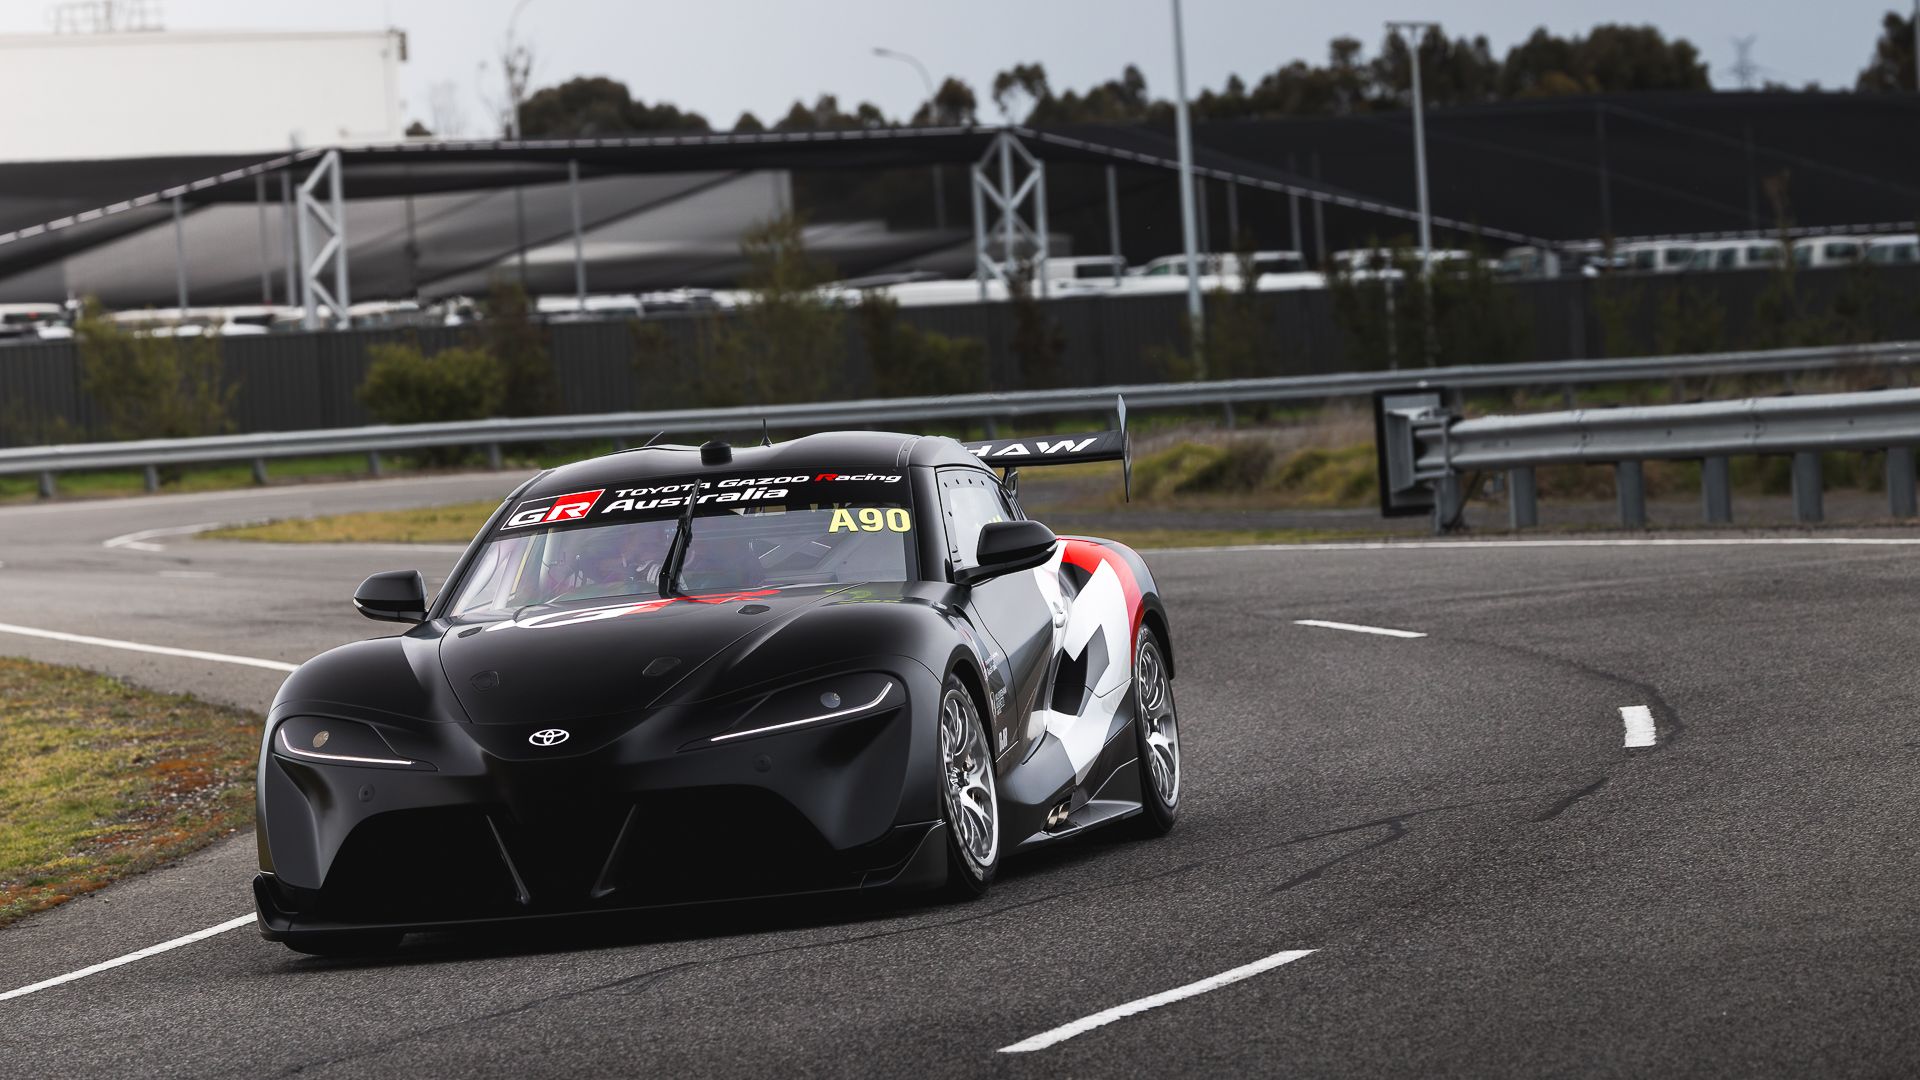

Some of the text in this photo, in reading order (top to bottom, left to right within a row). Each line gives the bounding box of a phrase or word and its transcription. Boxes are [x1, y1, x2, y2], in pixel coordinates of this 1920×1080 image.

[615, 473, 902, 498] TOYOTA GAZOO Racing
[600, 486, 789, 514] Australia
[508, 501, 591, 527] GR
[828, 507, 911, 533] A90
